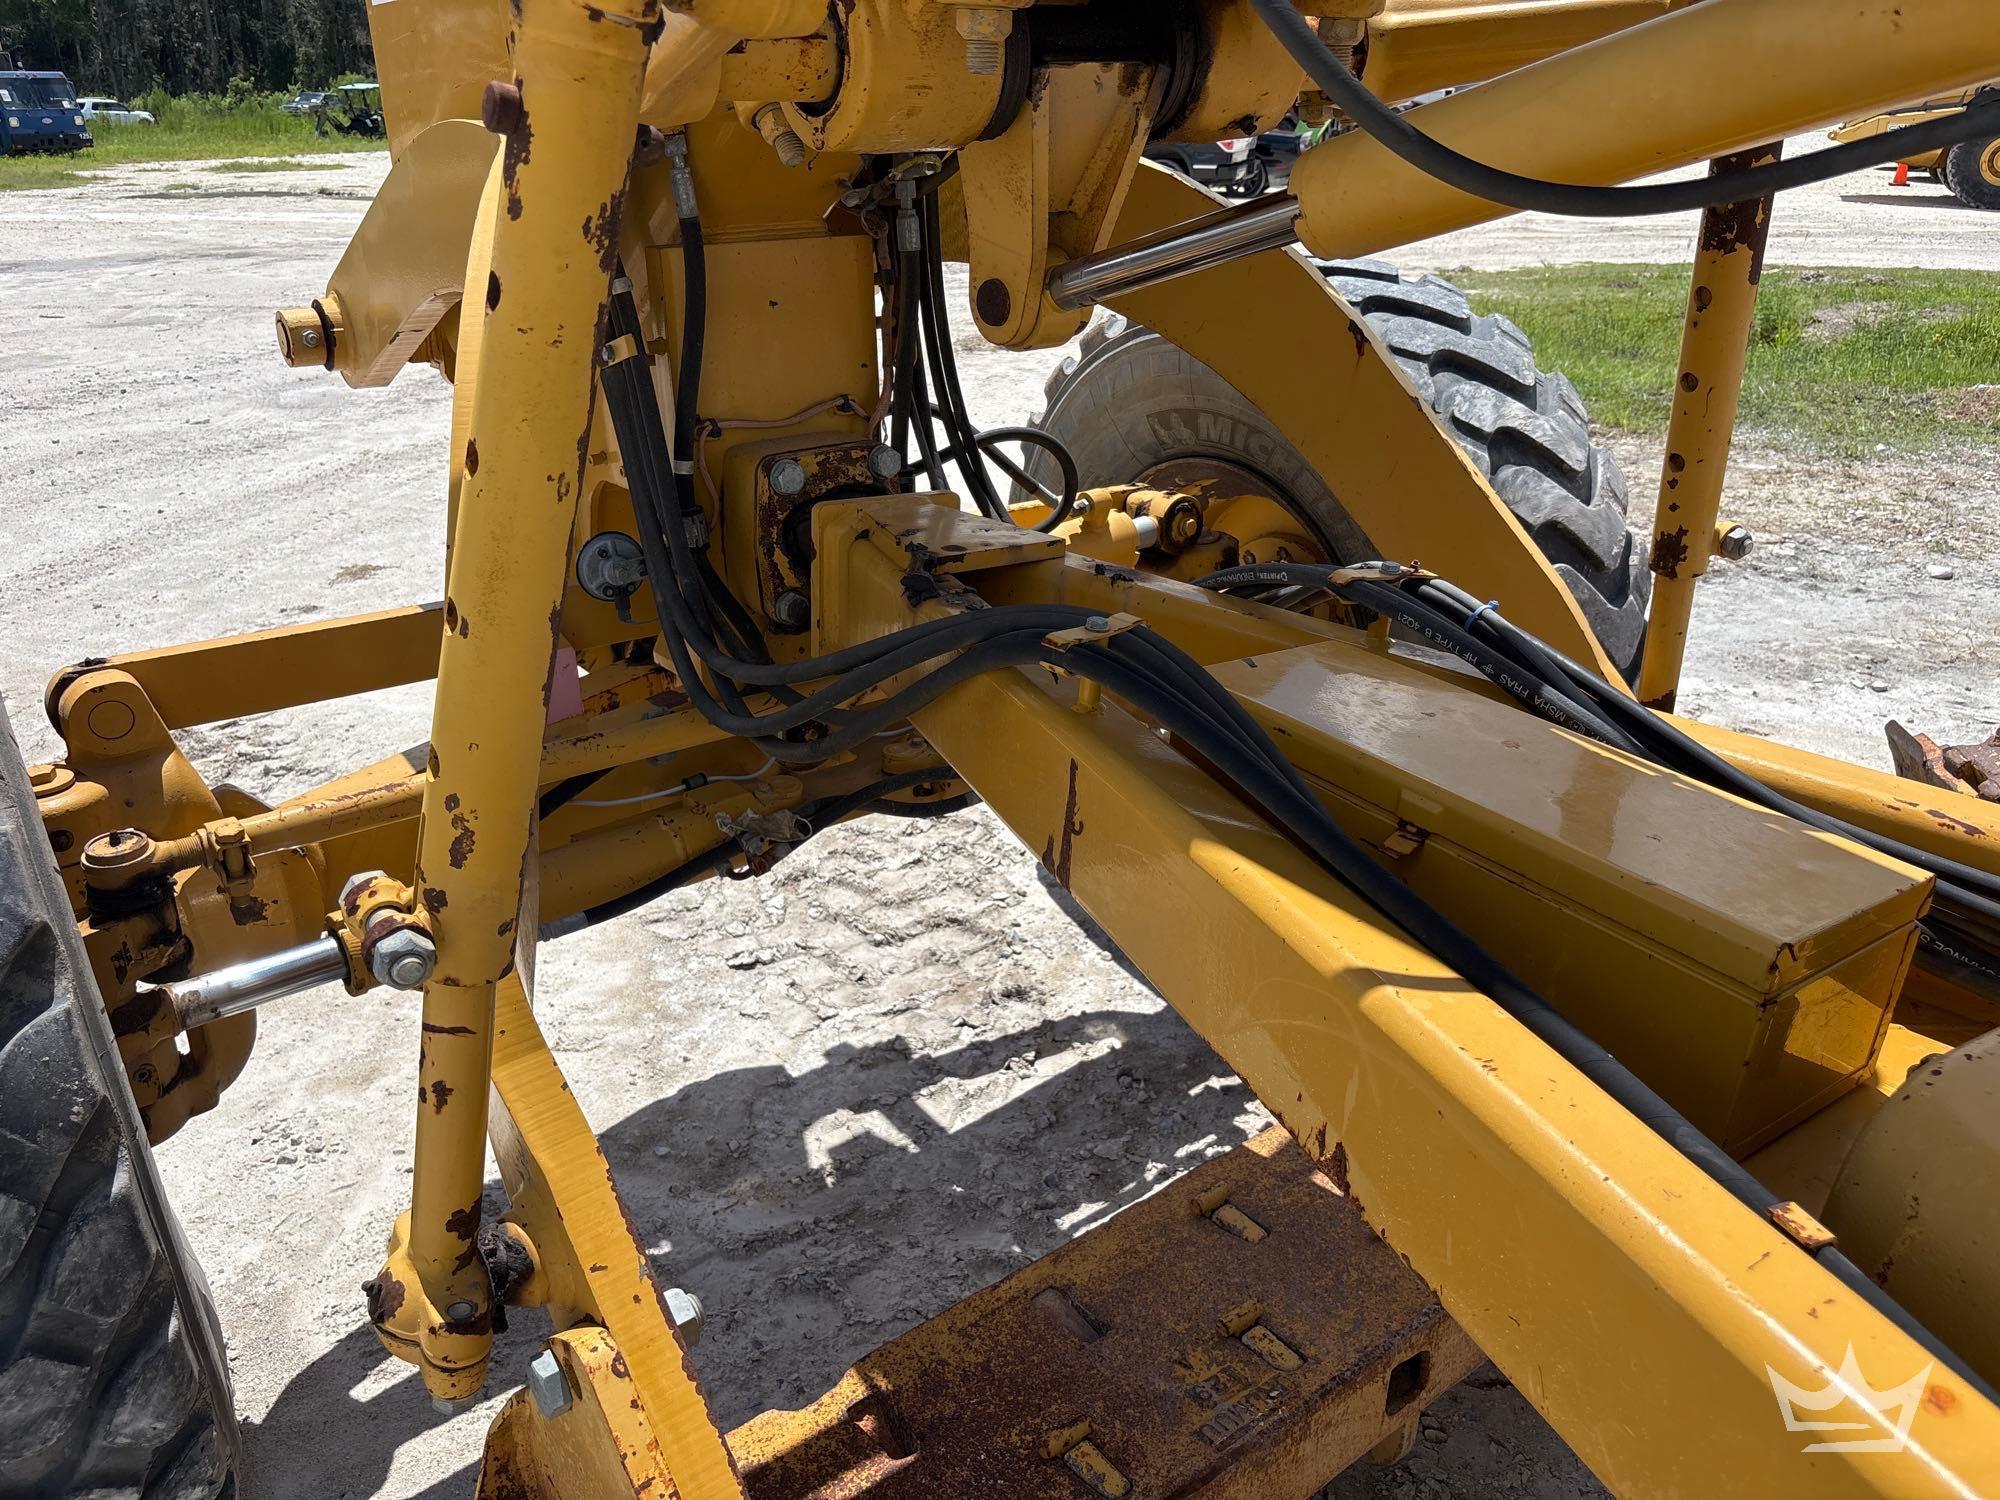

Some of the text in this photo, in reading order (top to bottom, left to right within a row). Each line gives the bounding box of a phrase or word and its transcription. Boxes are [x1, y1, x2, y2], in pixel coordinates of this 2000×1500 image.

[1397, 612, 1566, 722] MSHA FRAS HF TYPE B 4Q21
